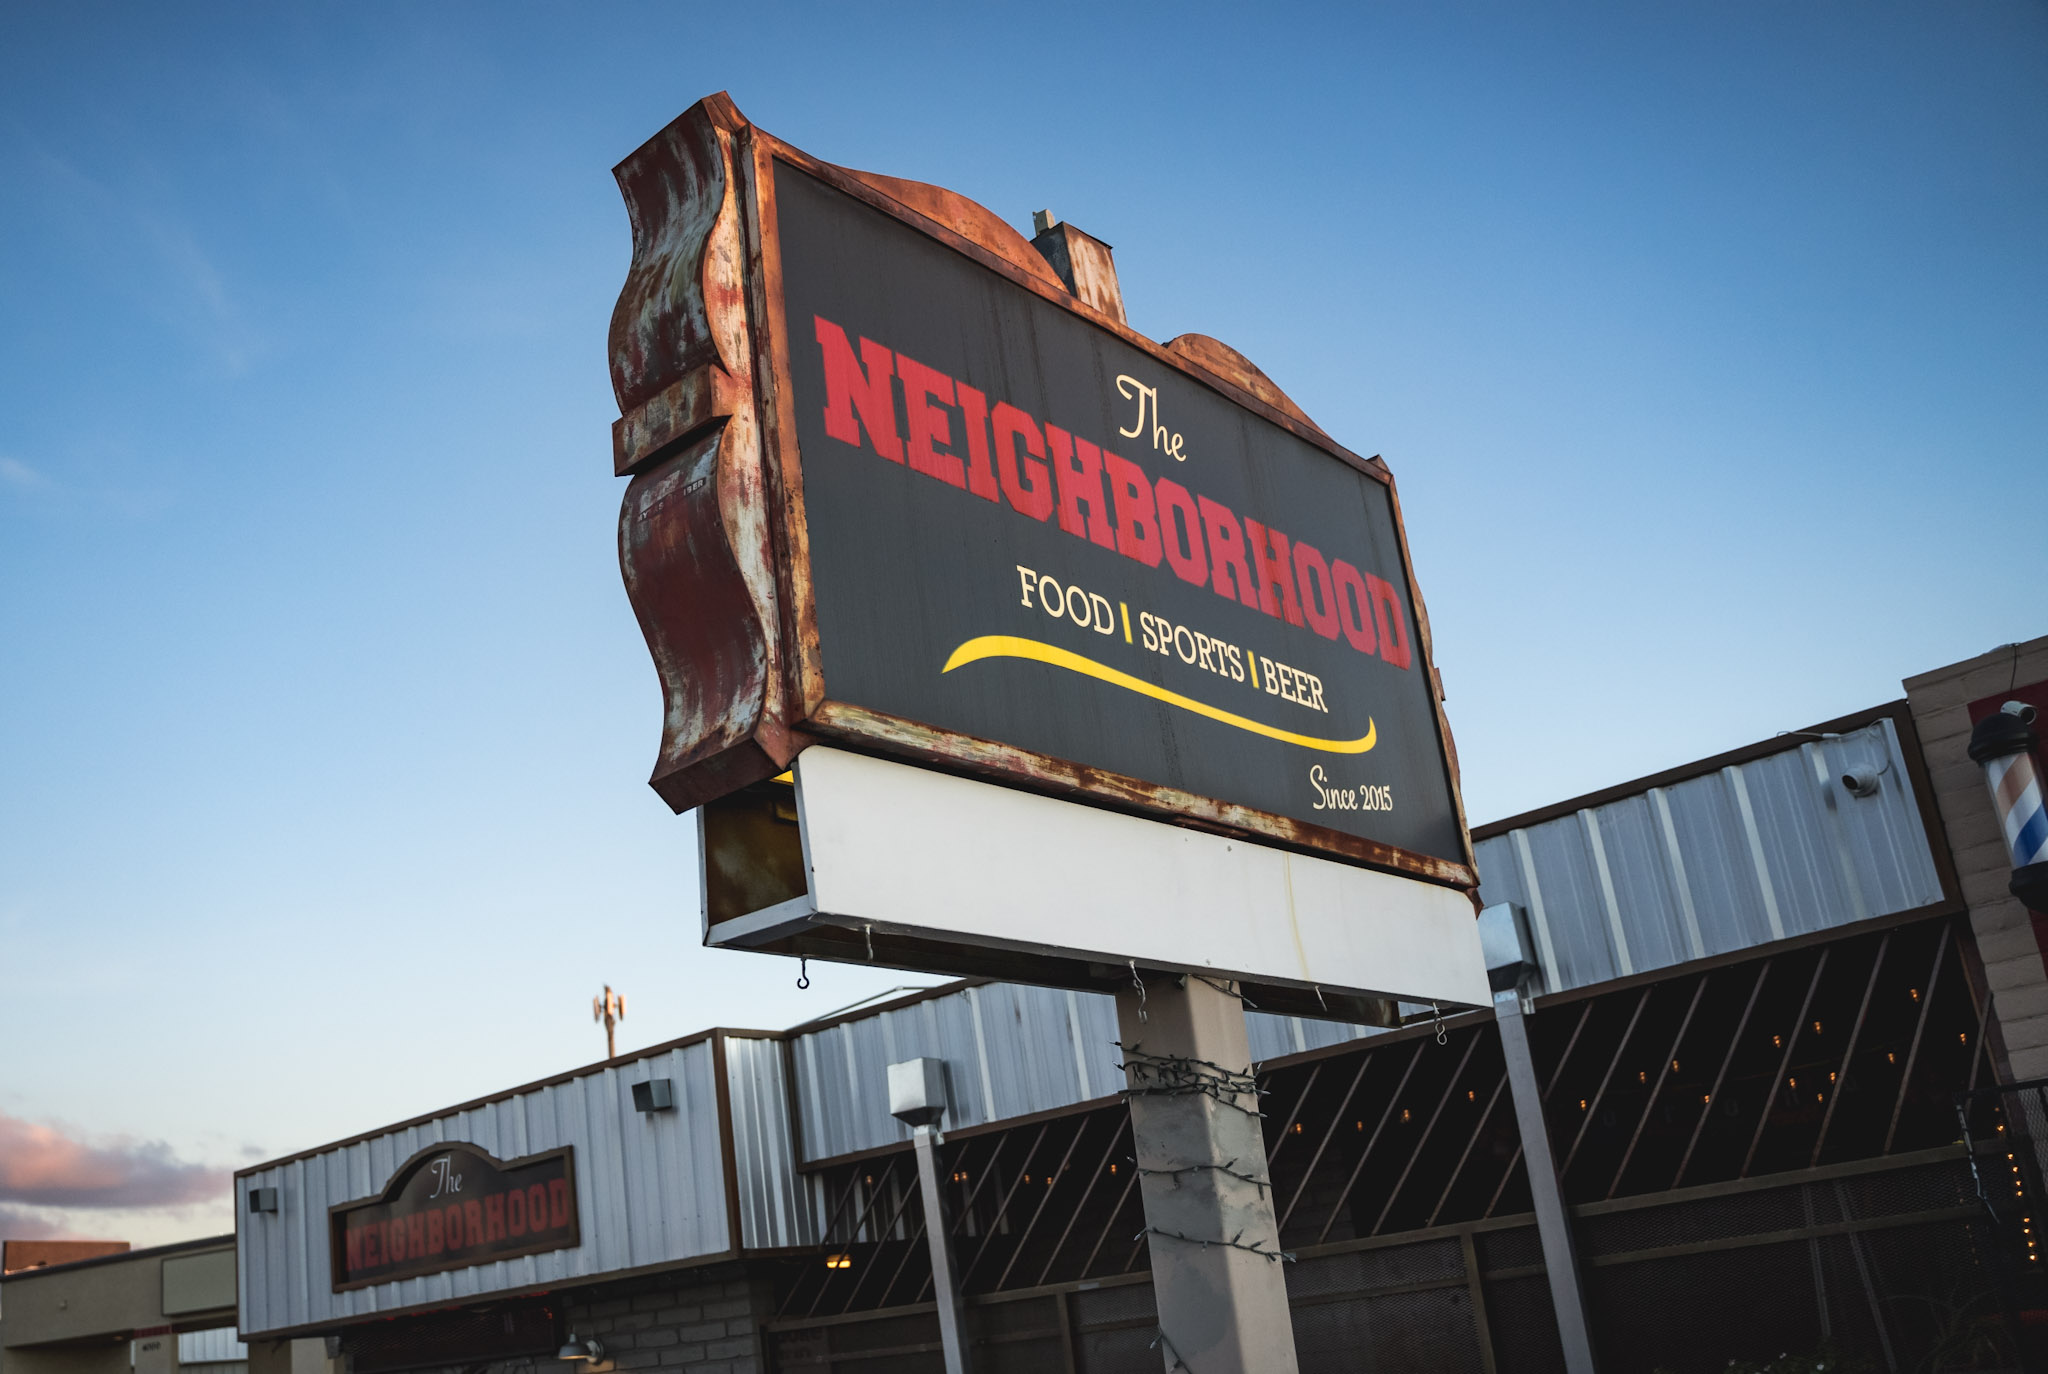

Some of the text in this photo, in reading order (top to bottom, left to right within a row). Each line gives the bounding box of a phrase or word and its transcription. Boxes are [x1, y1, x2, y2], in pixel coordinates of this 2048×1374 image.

[1115, 374, 1187, 462] The
[813, 314, 1413, 670] NEIGHBORHOOD
[1016, 564, 1329, 714] FOOD SPORTS BEER
[1309, 764, 1393, 812] Since 2015
[430, 1155, 463, 1199] The
[345, 1178, 570, 1271] NEIGHBORHOOD
